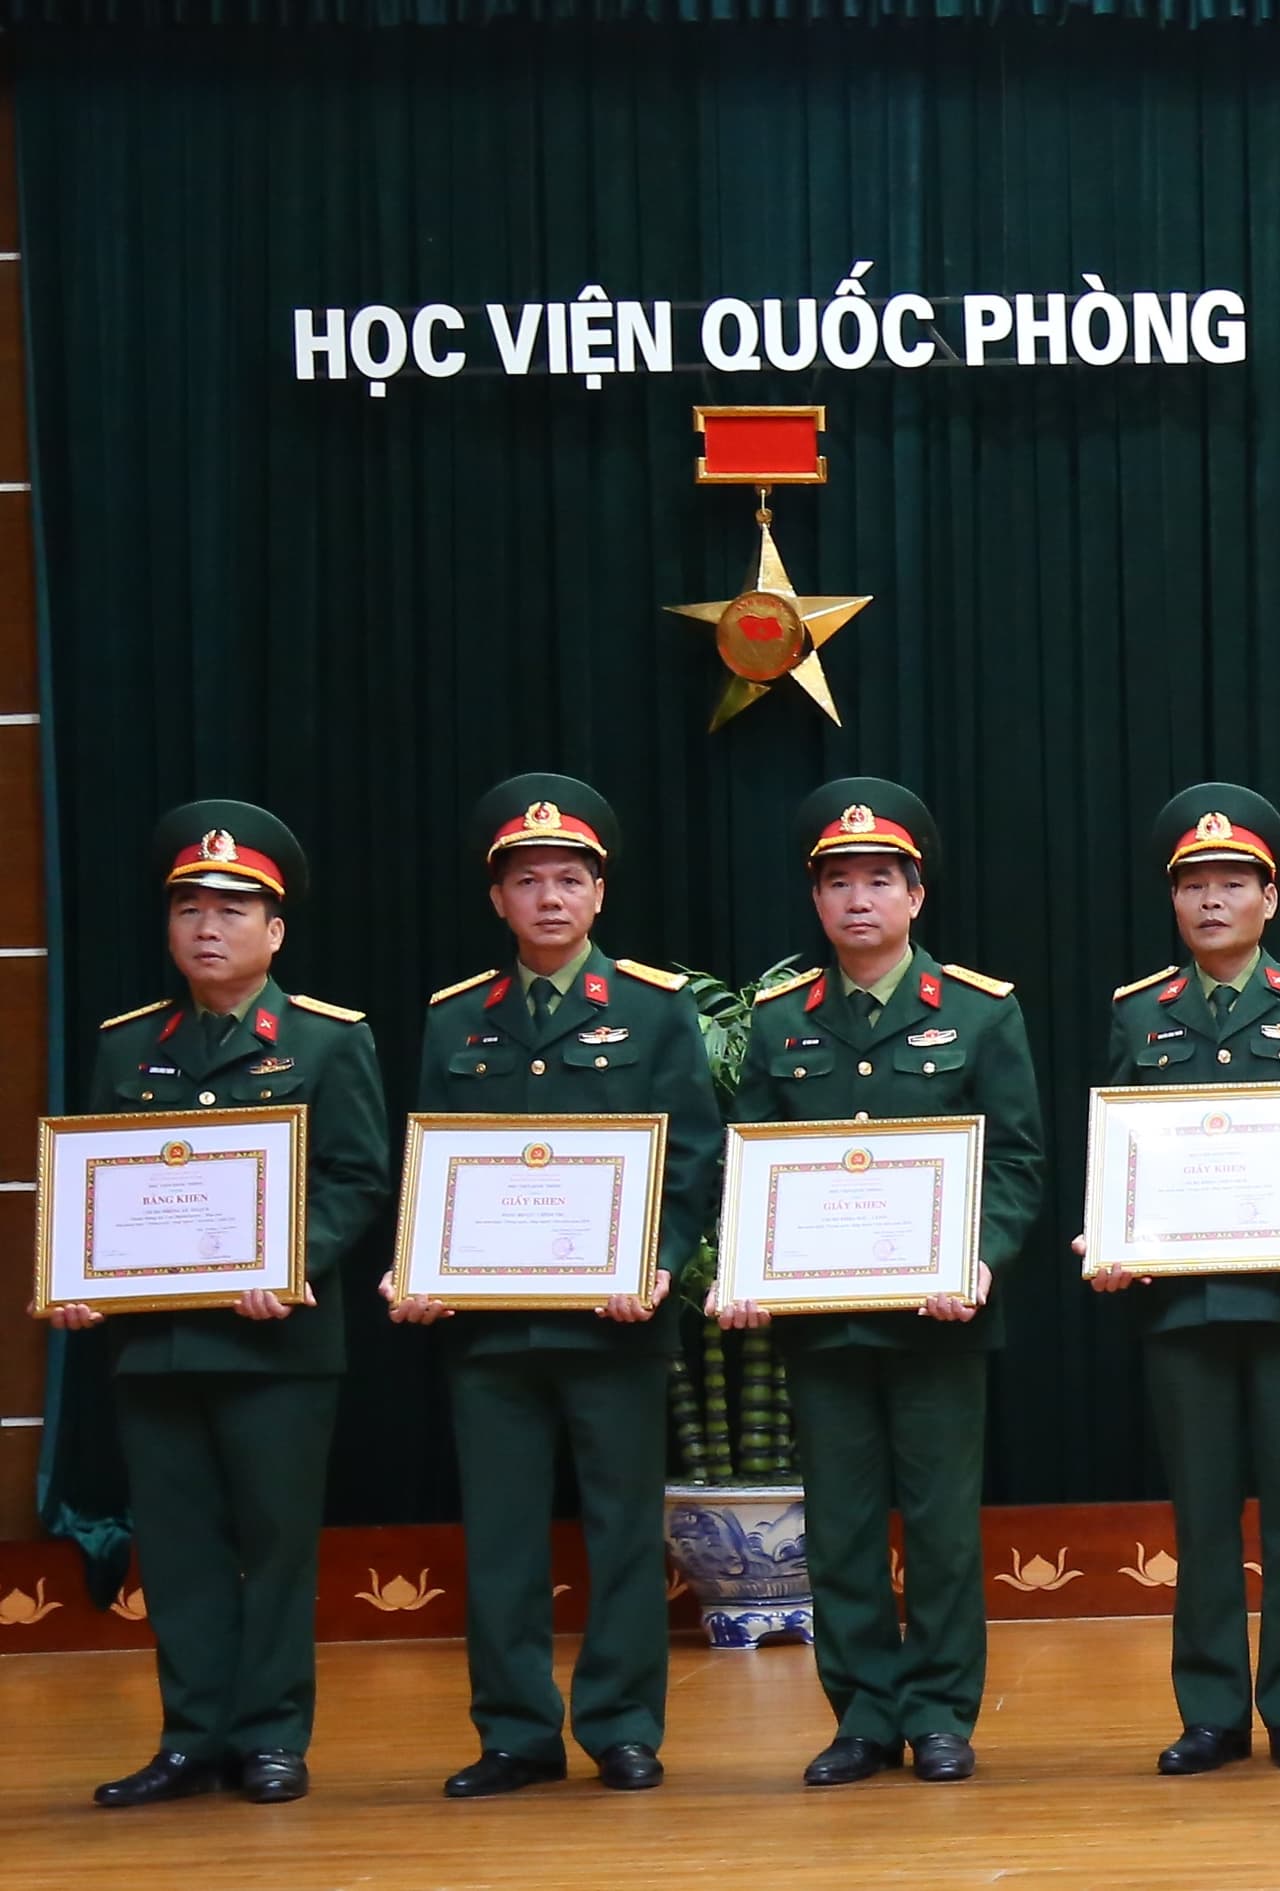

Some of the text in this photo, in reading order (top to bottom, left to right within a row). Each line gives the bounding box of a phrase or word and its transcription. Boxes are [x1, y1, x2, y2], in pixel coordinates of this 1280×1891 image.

[294, 261, 1246, 398] HỌC VIỆN QUỐC PHÒNG
